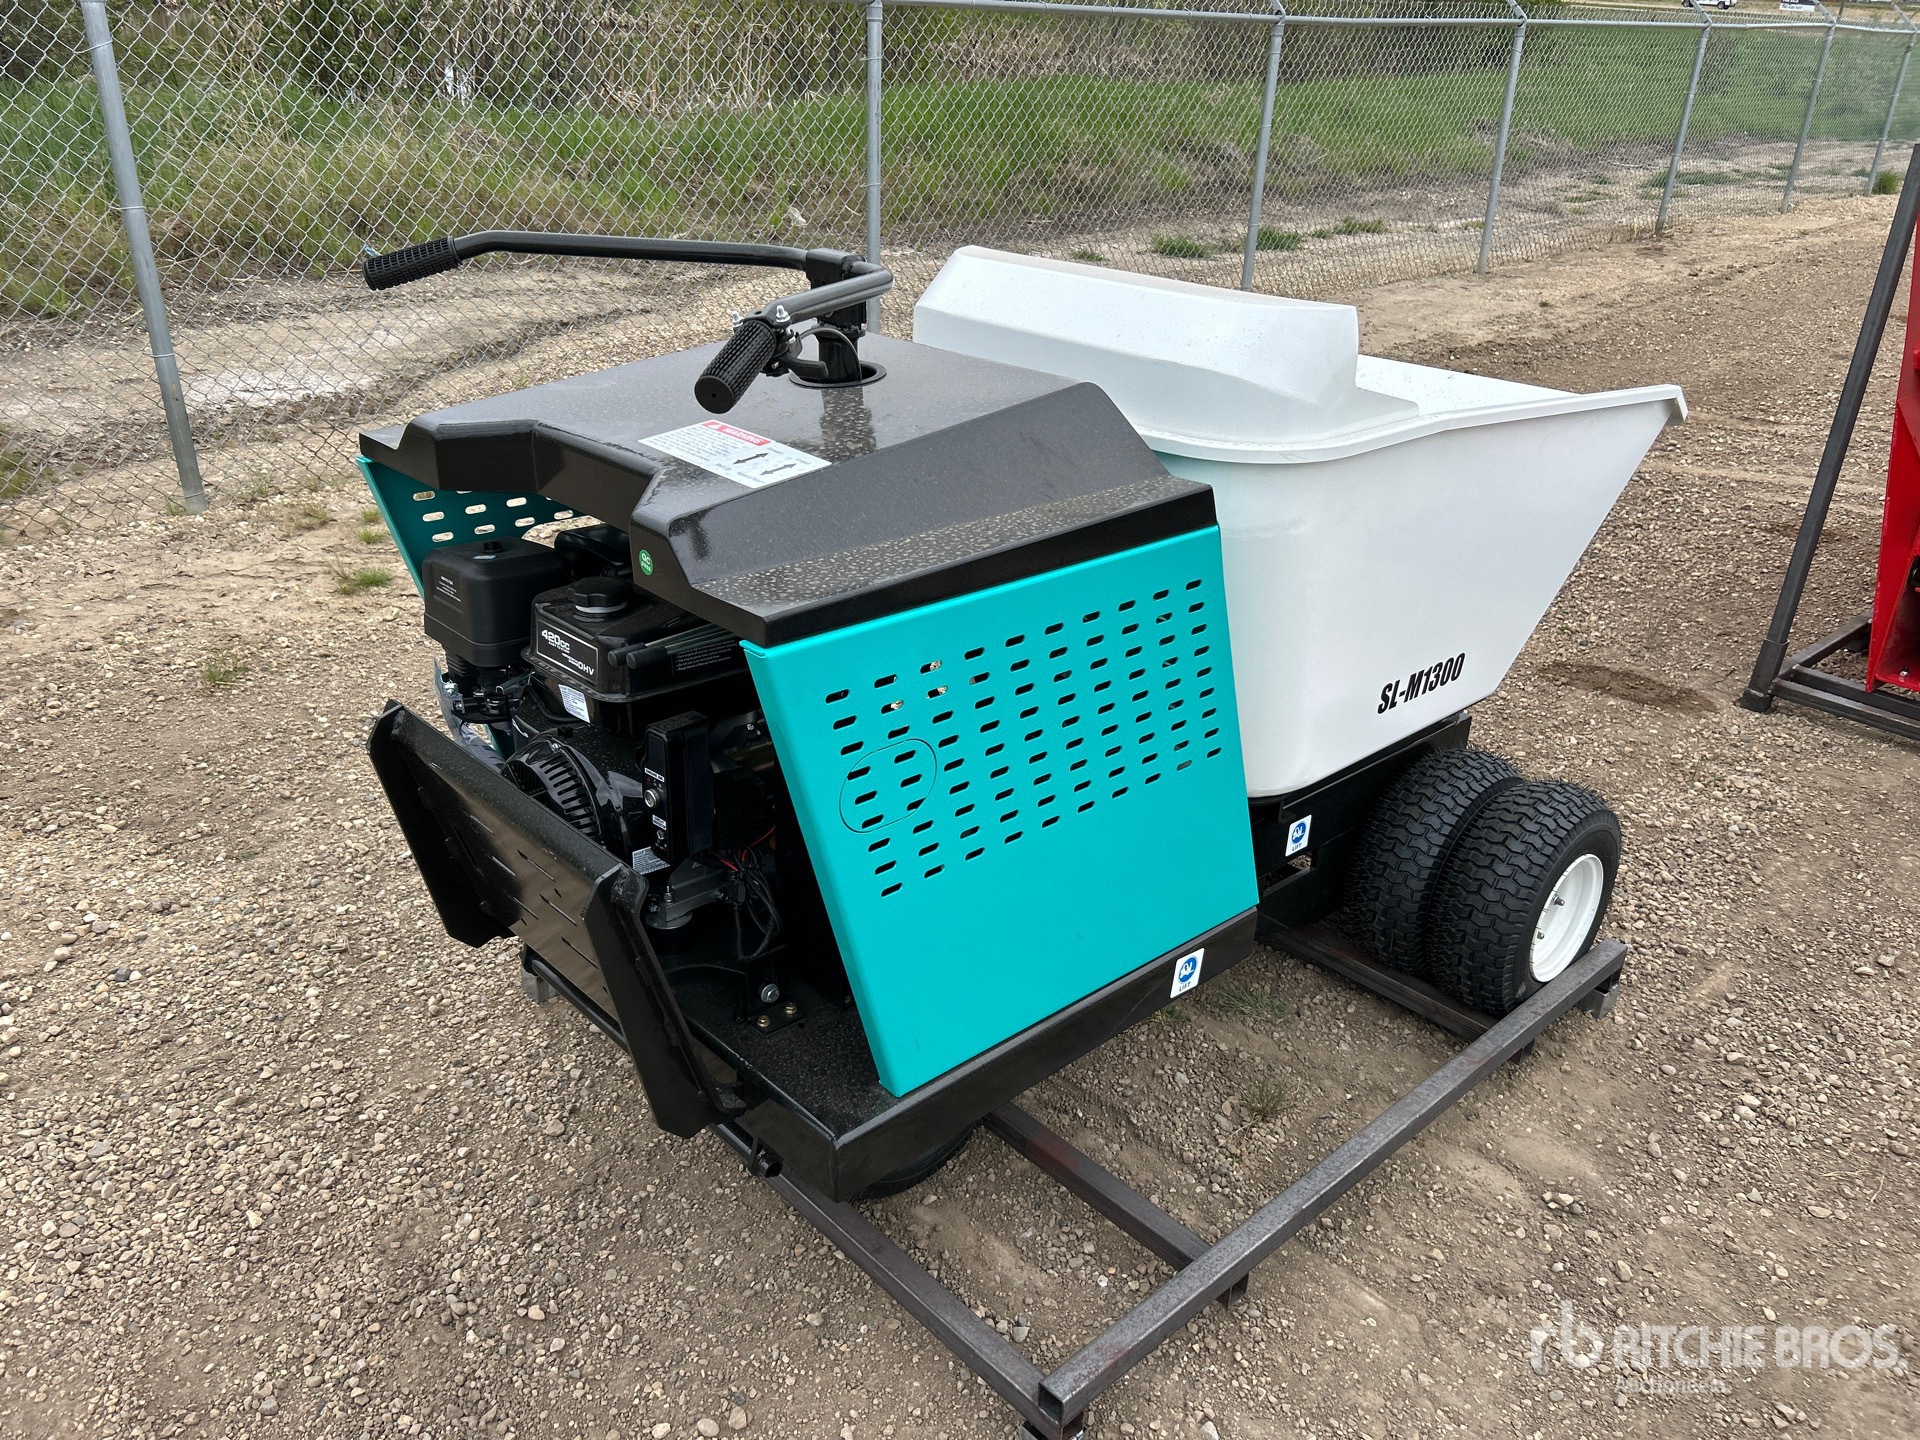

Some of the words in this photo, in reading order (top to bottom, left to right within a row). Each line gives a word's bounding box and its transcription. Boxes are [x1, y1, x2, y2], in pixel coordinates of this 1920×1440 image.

[541, 629, 570, 651] 420cc
[578, 661, 595, 676] OHV
[1377, 652, 1465, 715] SL-M1300
